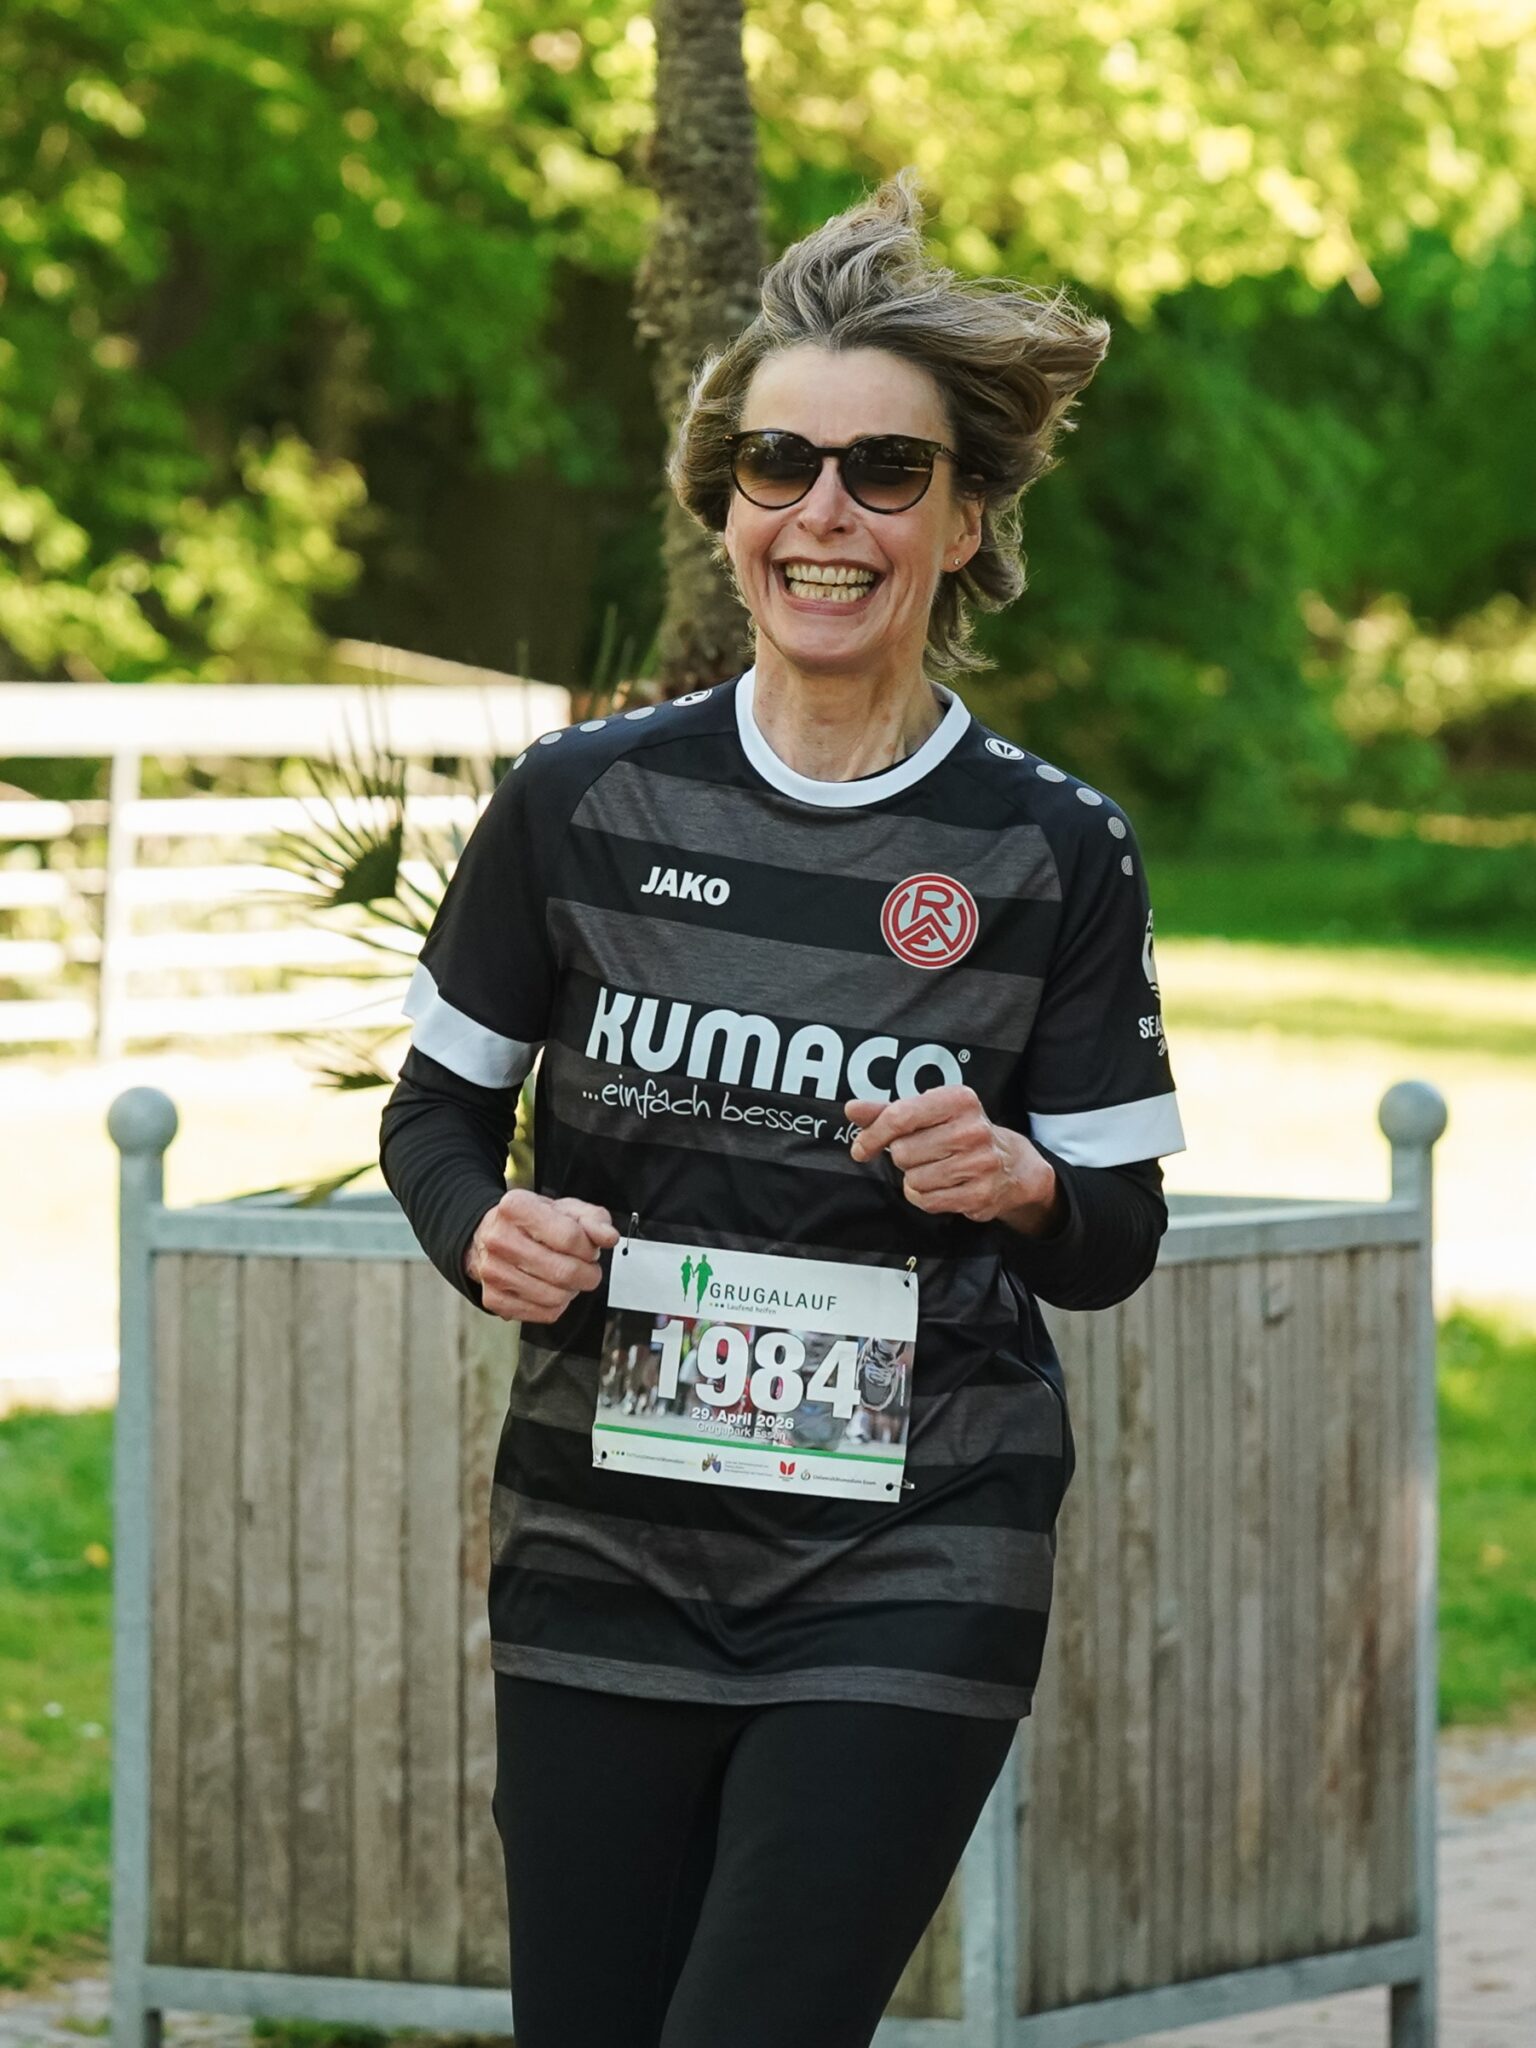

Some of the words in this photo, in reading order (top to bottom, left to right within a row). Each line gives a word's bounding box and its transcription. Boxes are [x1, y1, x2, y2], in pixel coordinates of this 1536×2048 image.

[640, 866, 730, 906] JAKO
[1138, 1014, 1164, 1039] SEA
[721, 1092, 827, 1138] besser
[709, 1282, 838, 1311] GRUGALAUF
[651, 1318, 862, 1420] 1984
[691, 1406, 713, 1420] 29.
[716, 1409, 752, 1426] April
[756, 1414, 794, 1429] 2026
